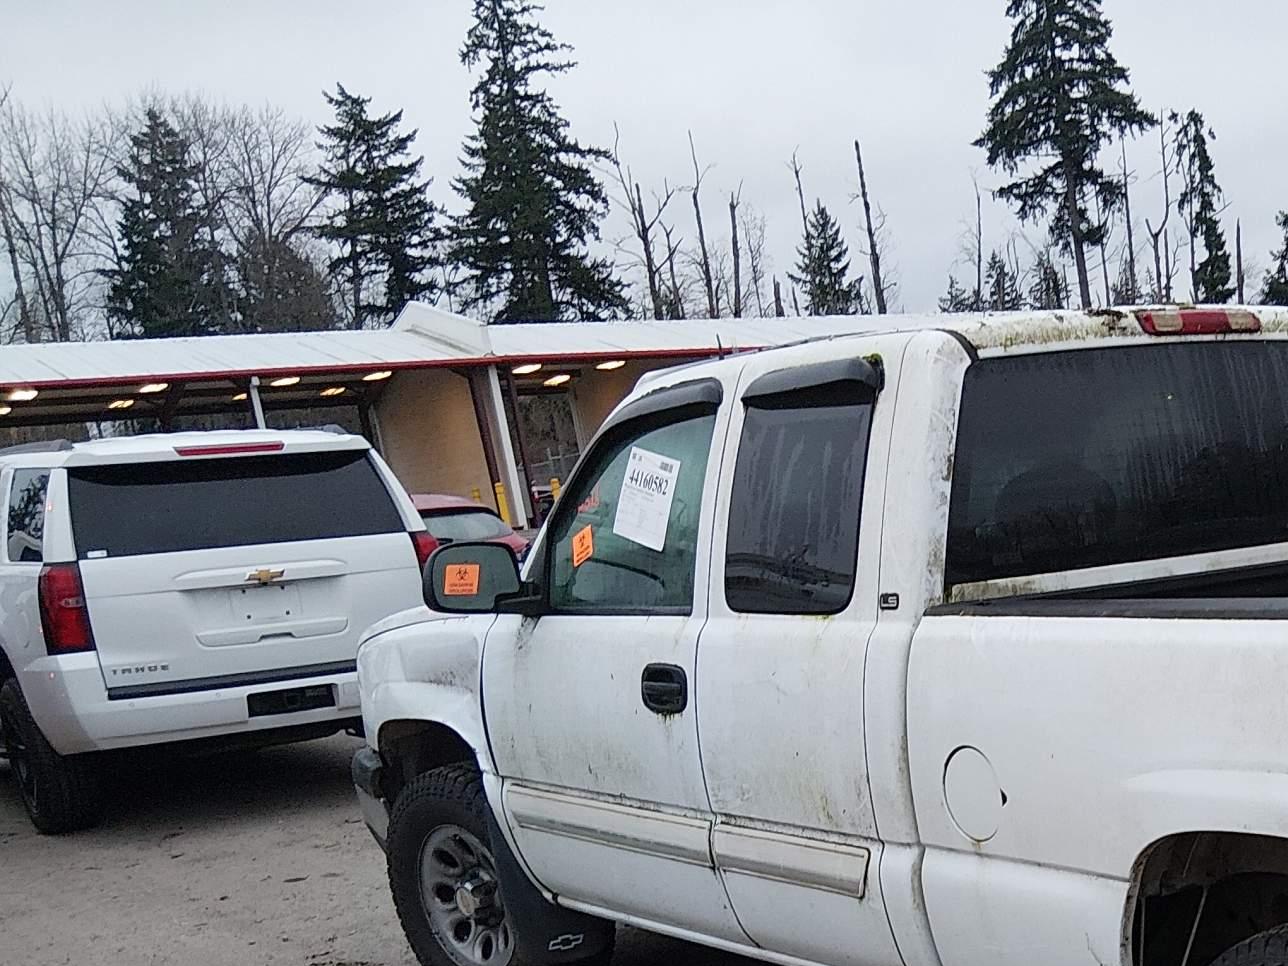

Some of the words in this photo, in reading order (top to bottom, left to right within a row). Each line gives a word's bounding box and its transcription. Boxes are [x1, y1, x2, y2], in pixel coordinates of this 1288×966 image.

[628, 467, 669, 496] 44160582
[880, 595, 898, 608] LS
[111, 663, 169, 676] TAHOE
